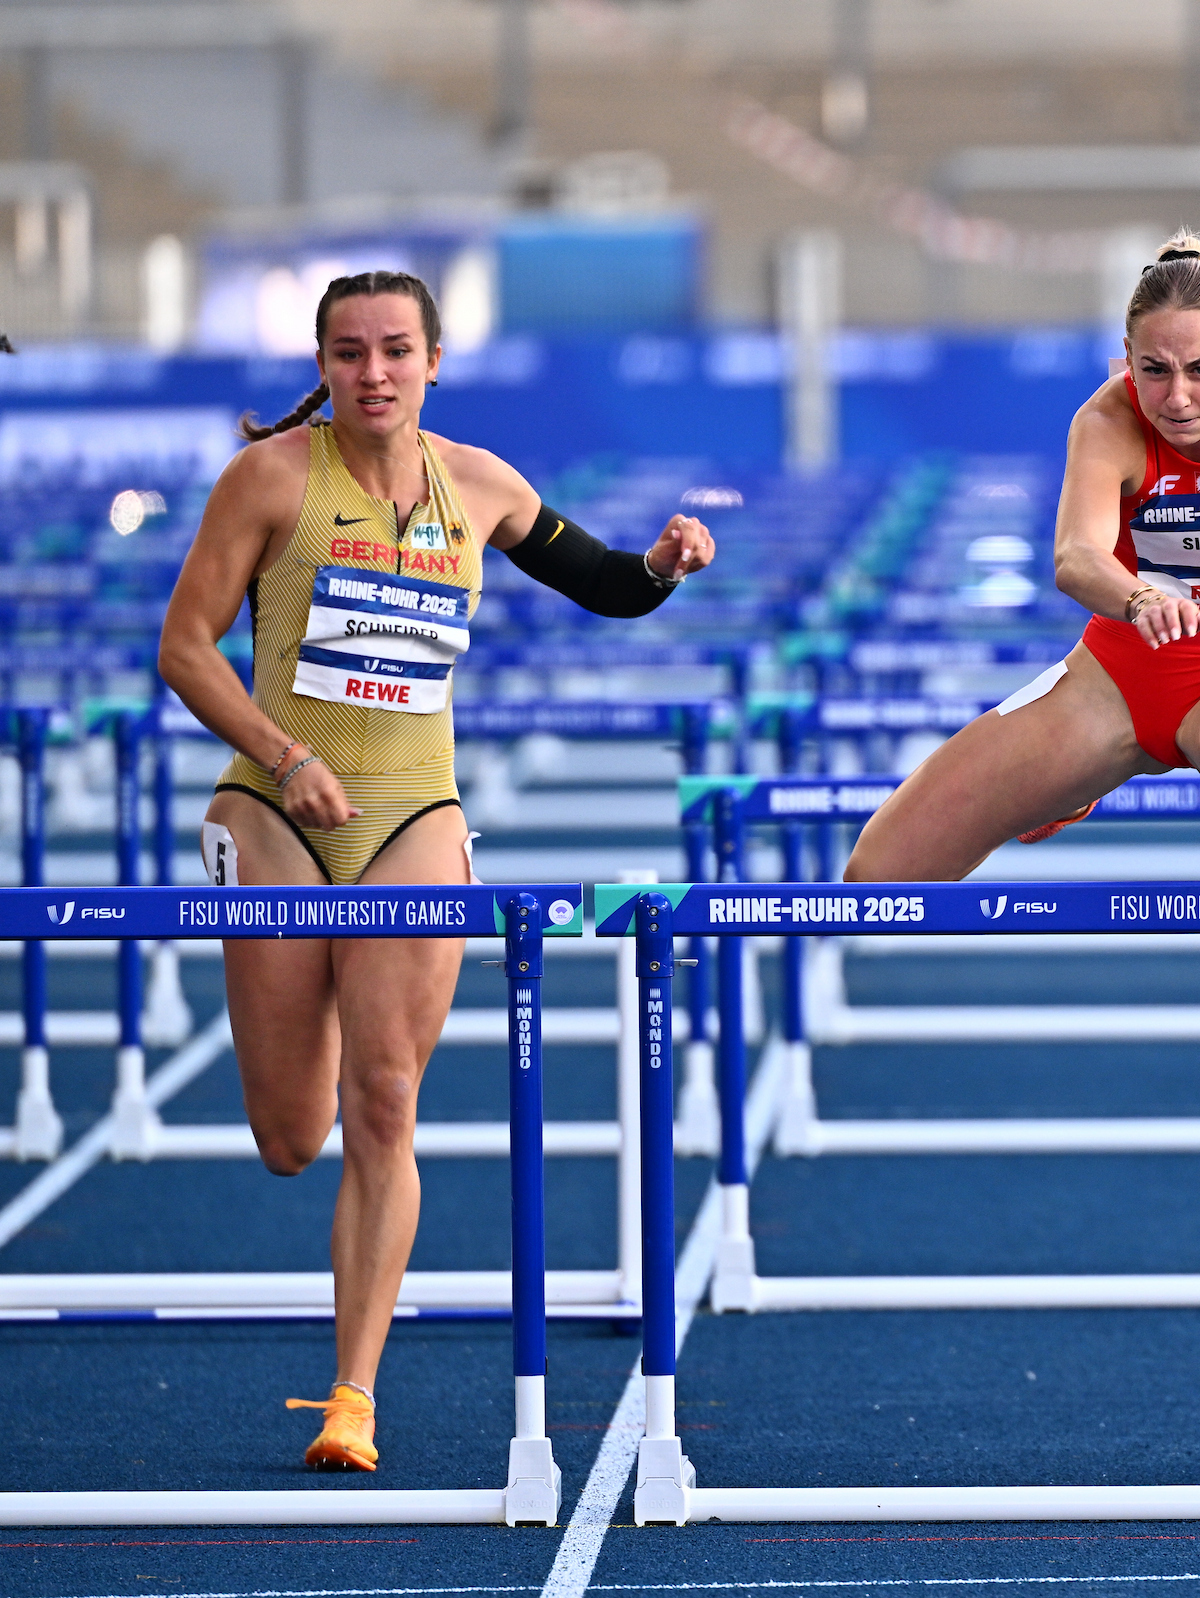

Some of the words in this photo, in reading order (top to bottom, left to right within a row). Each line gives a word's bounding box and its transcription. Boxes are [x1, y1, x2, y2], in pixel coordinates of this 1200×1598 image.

[331, 539, 460, 575] GERMANY
[328, 578, 420, 611] RHINE-RUHR
[420, 594, 458, 617] 2025
[381, 663, 404, 673] FISU
[345, 678, 411, 704] REWE
[215, 841, 226, 886] 5
[81, 907, 126, 919] FISU
[179, 901, 219, 926] FISU
[226, 901, 289, 926] WORLD
[295, 901, 399, 926] UNIVERSITY
[405, 901, 466, 926] GAMES
[709, 897, 859, 923] RHINE-RUHR
[864, 897, 925, 922] 2025
[1013, 902, 1057, 914] FISU
[1110, 895, 1149, 920] FISU
[515, 1008, 533, 1069] MONDO
[647, 1001, 663, 1069] MONDO
